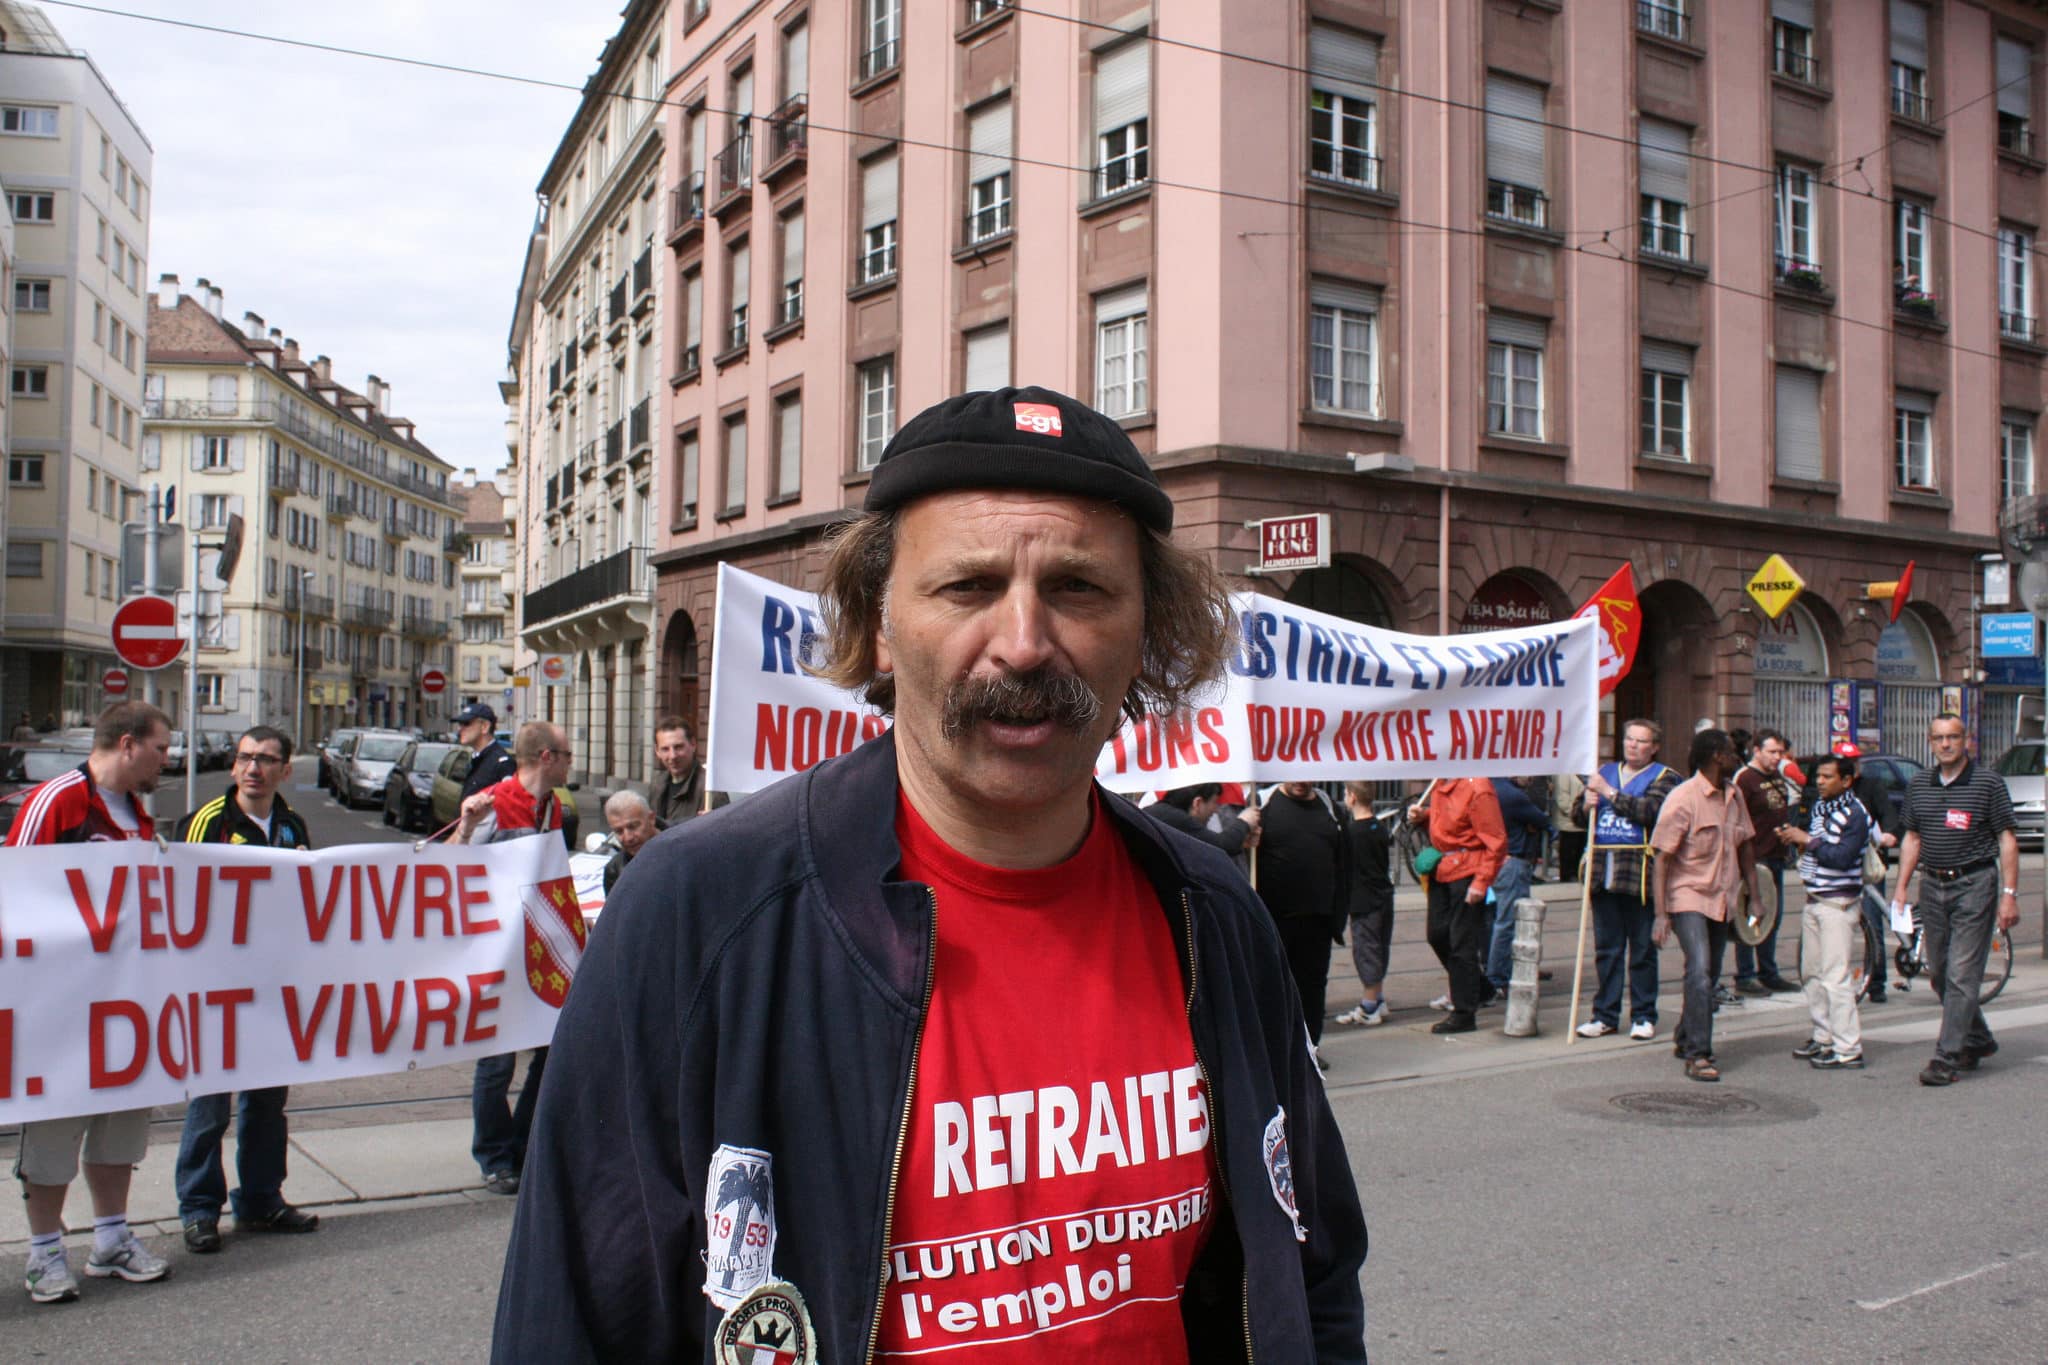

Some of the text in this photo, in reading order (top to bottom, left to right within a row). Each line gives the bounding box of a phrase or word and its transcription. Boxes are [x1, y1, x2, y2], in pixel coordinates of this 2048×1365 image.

[1267, 537, 1313, 556] HONG
[1269, 522, 1312, 540] TOFU
[1751, 581, 1795, 592] PRESSE
[1391, 642, 1448, 690] ET
[1333, 709, 1437, 762] NOTRE
[1449, 709, 1546, 760] AVENIR
[64, 865, 272, 953] VEUT
[298, 864, 501, 942] VIVRE
[89, 988, 255, 1090] DOIT
[281, 970, 506, 1062] VIVRE
[901, 1253, 1132, 1339] l'emploi
